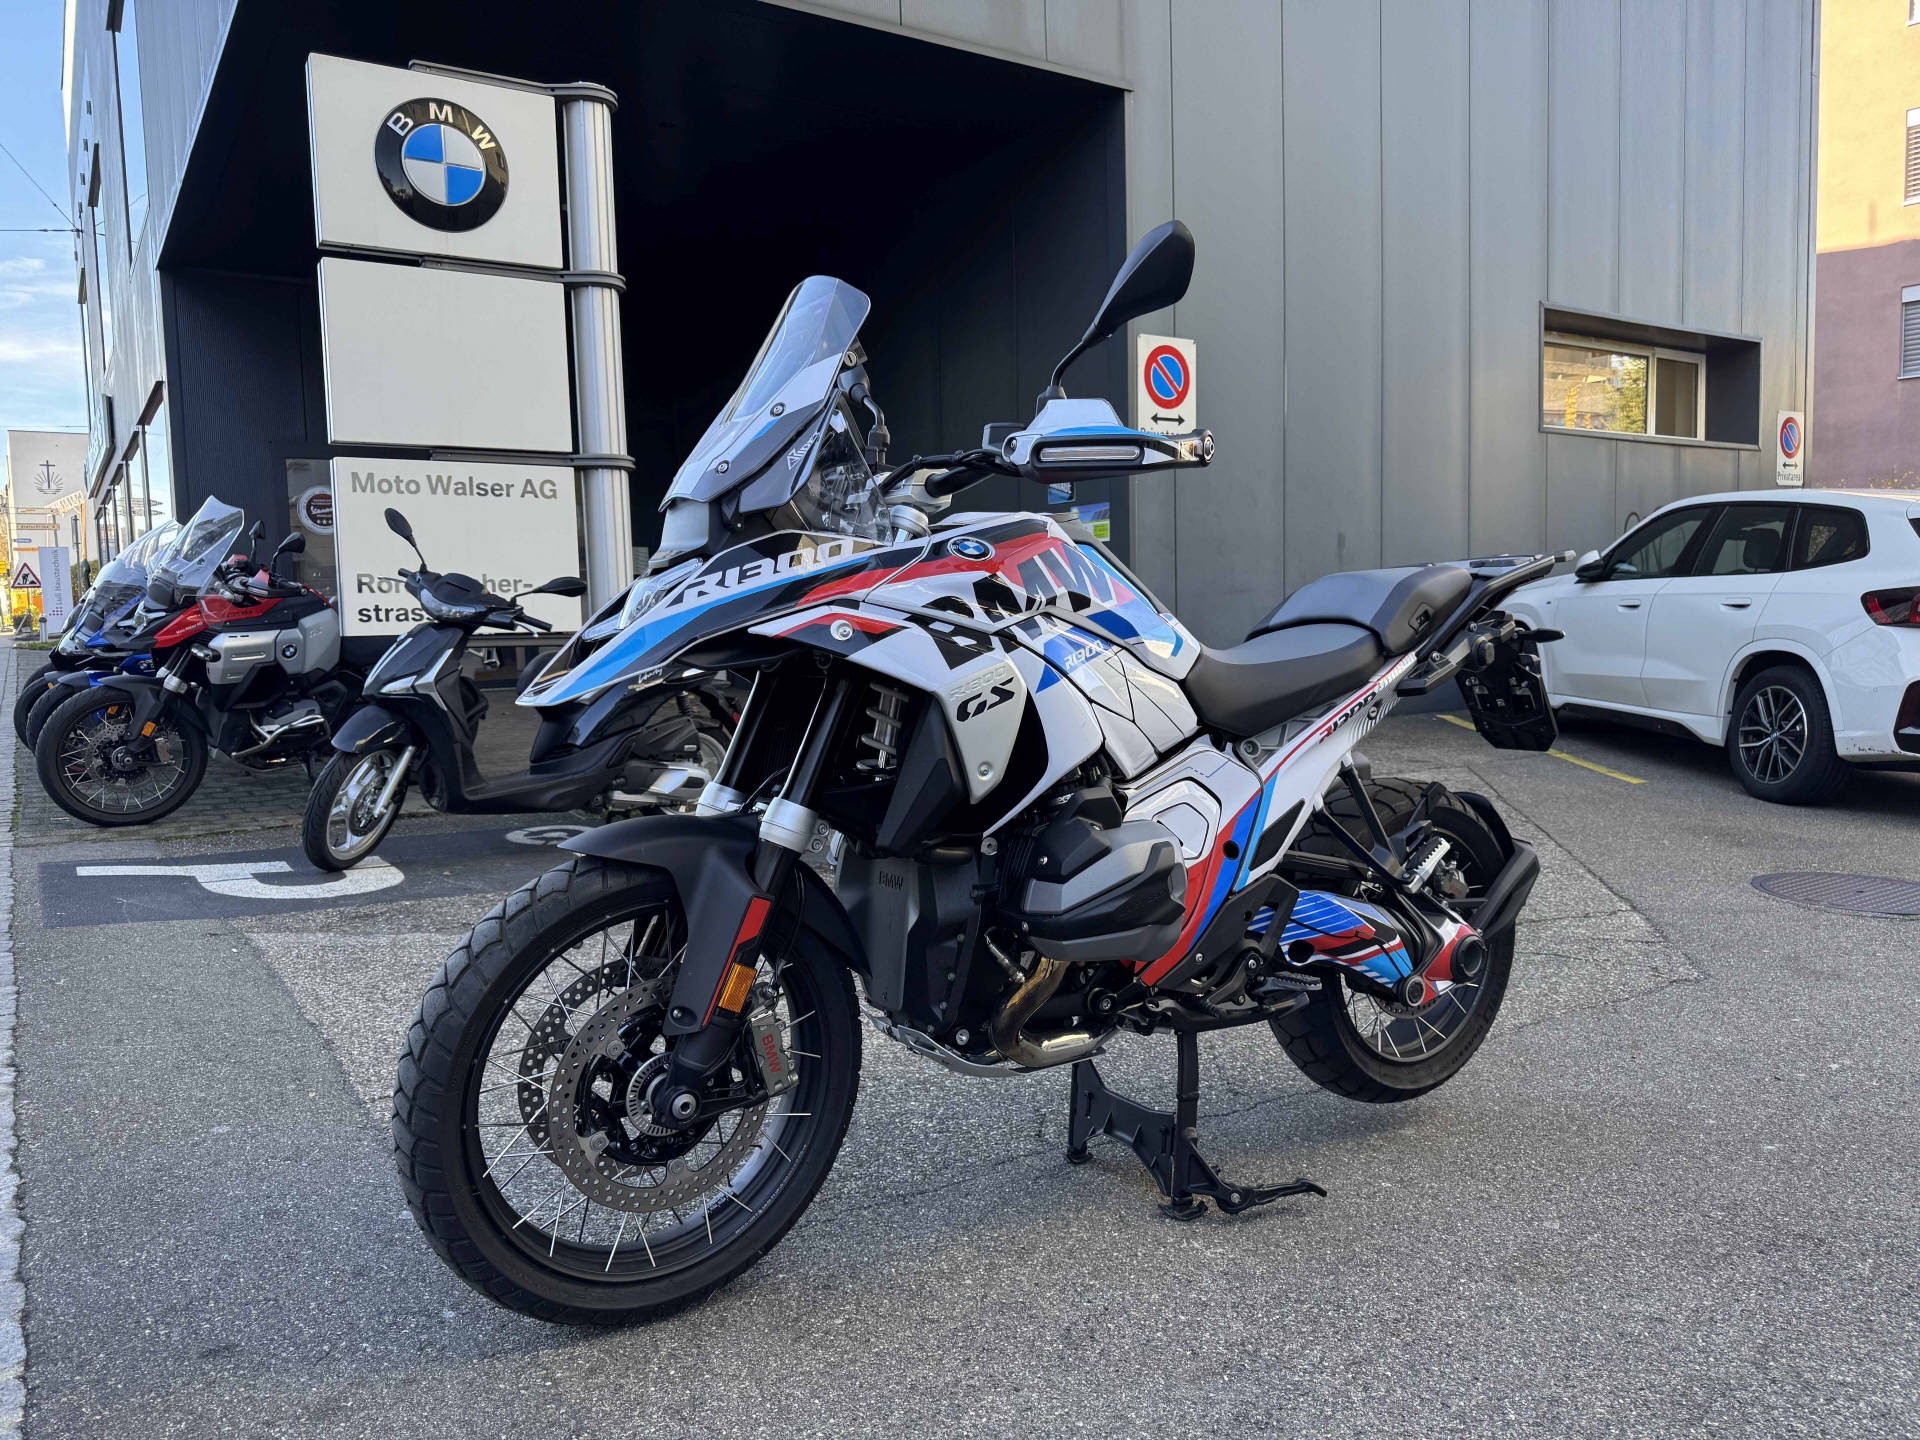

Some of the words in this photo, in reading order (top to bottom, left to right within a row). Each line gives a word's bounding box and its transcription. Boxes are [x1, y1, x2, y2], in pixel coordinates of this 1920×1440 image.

[386, 101, 497, 151] BMW
[350, 471, 422, 495] Moto
[426, 474, 515, 498] Walser
[520, 478, 558, 499] AG
[956, 676, 1016, 722] GS
[879, 870, 905, 891] BMW
[761, 1033, 782, 1073] BMW
